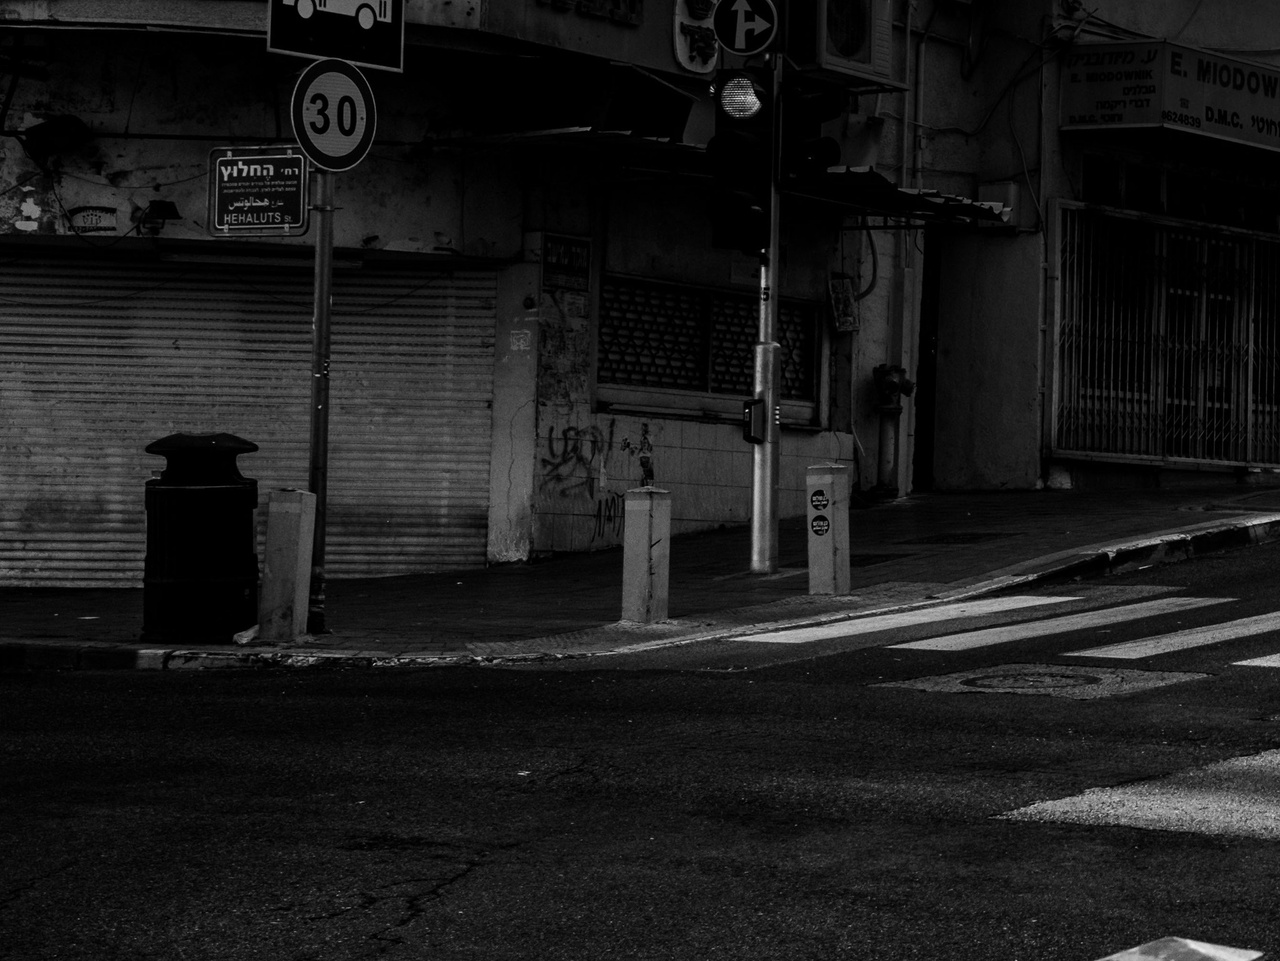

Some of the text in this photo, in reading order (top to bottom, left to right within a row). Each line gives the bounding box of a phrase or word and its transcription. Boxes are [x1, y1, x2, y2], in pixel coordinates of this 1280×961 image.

[1170, 51, 1188, 78] E.
[1085, 69, 1153, 82] MIODOWNIK
[309, 93, 357, 137] 30
[1161, 110, 1201, 128] 8624839
[1205, 106, 1244, 129] D.M.C.
[223, 212, 281, 224] HEHALUTS
